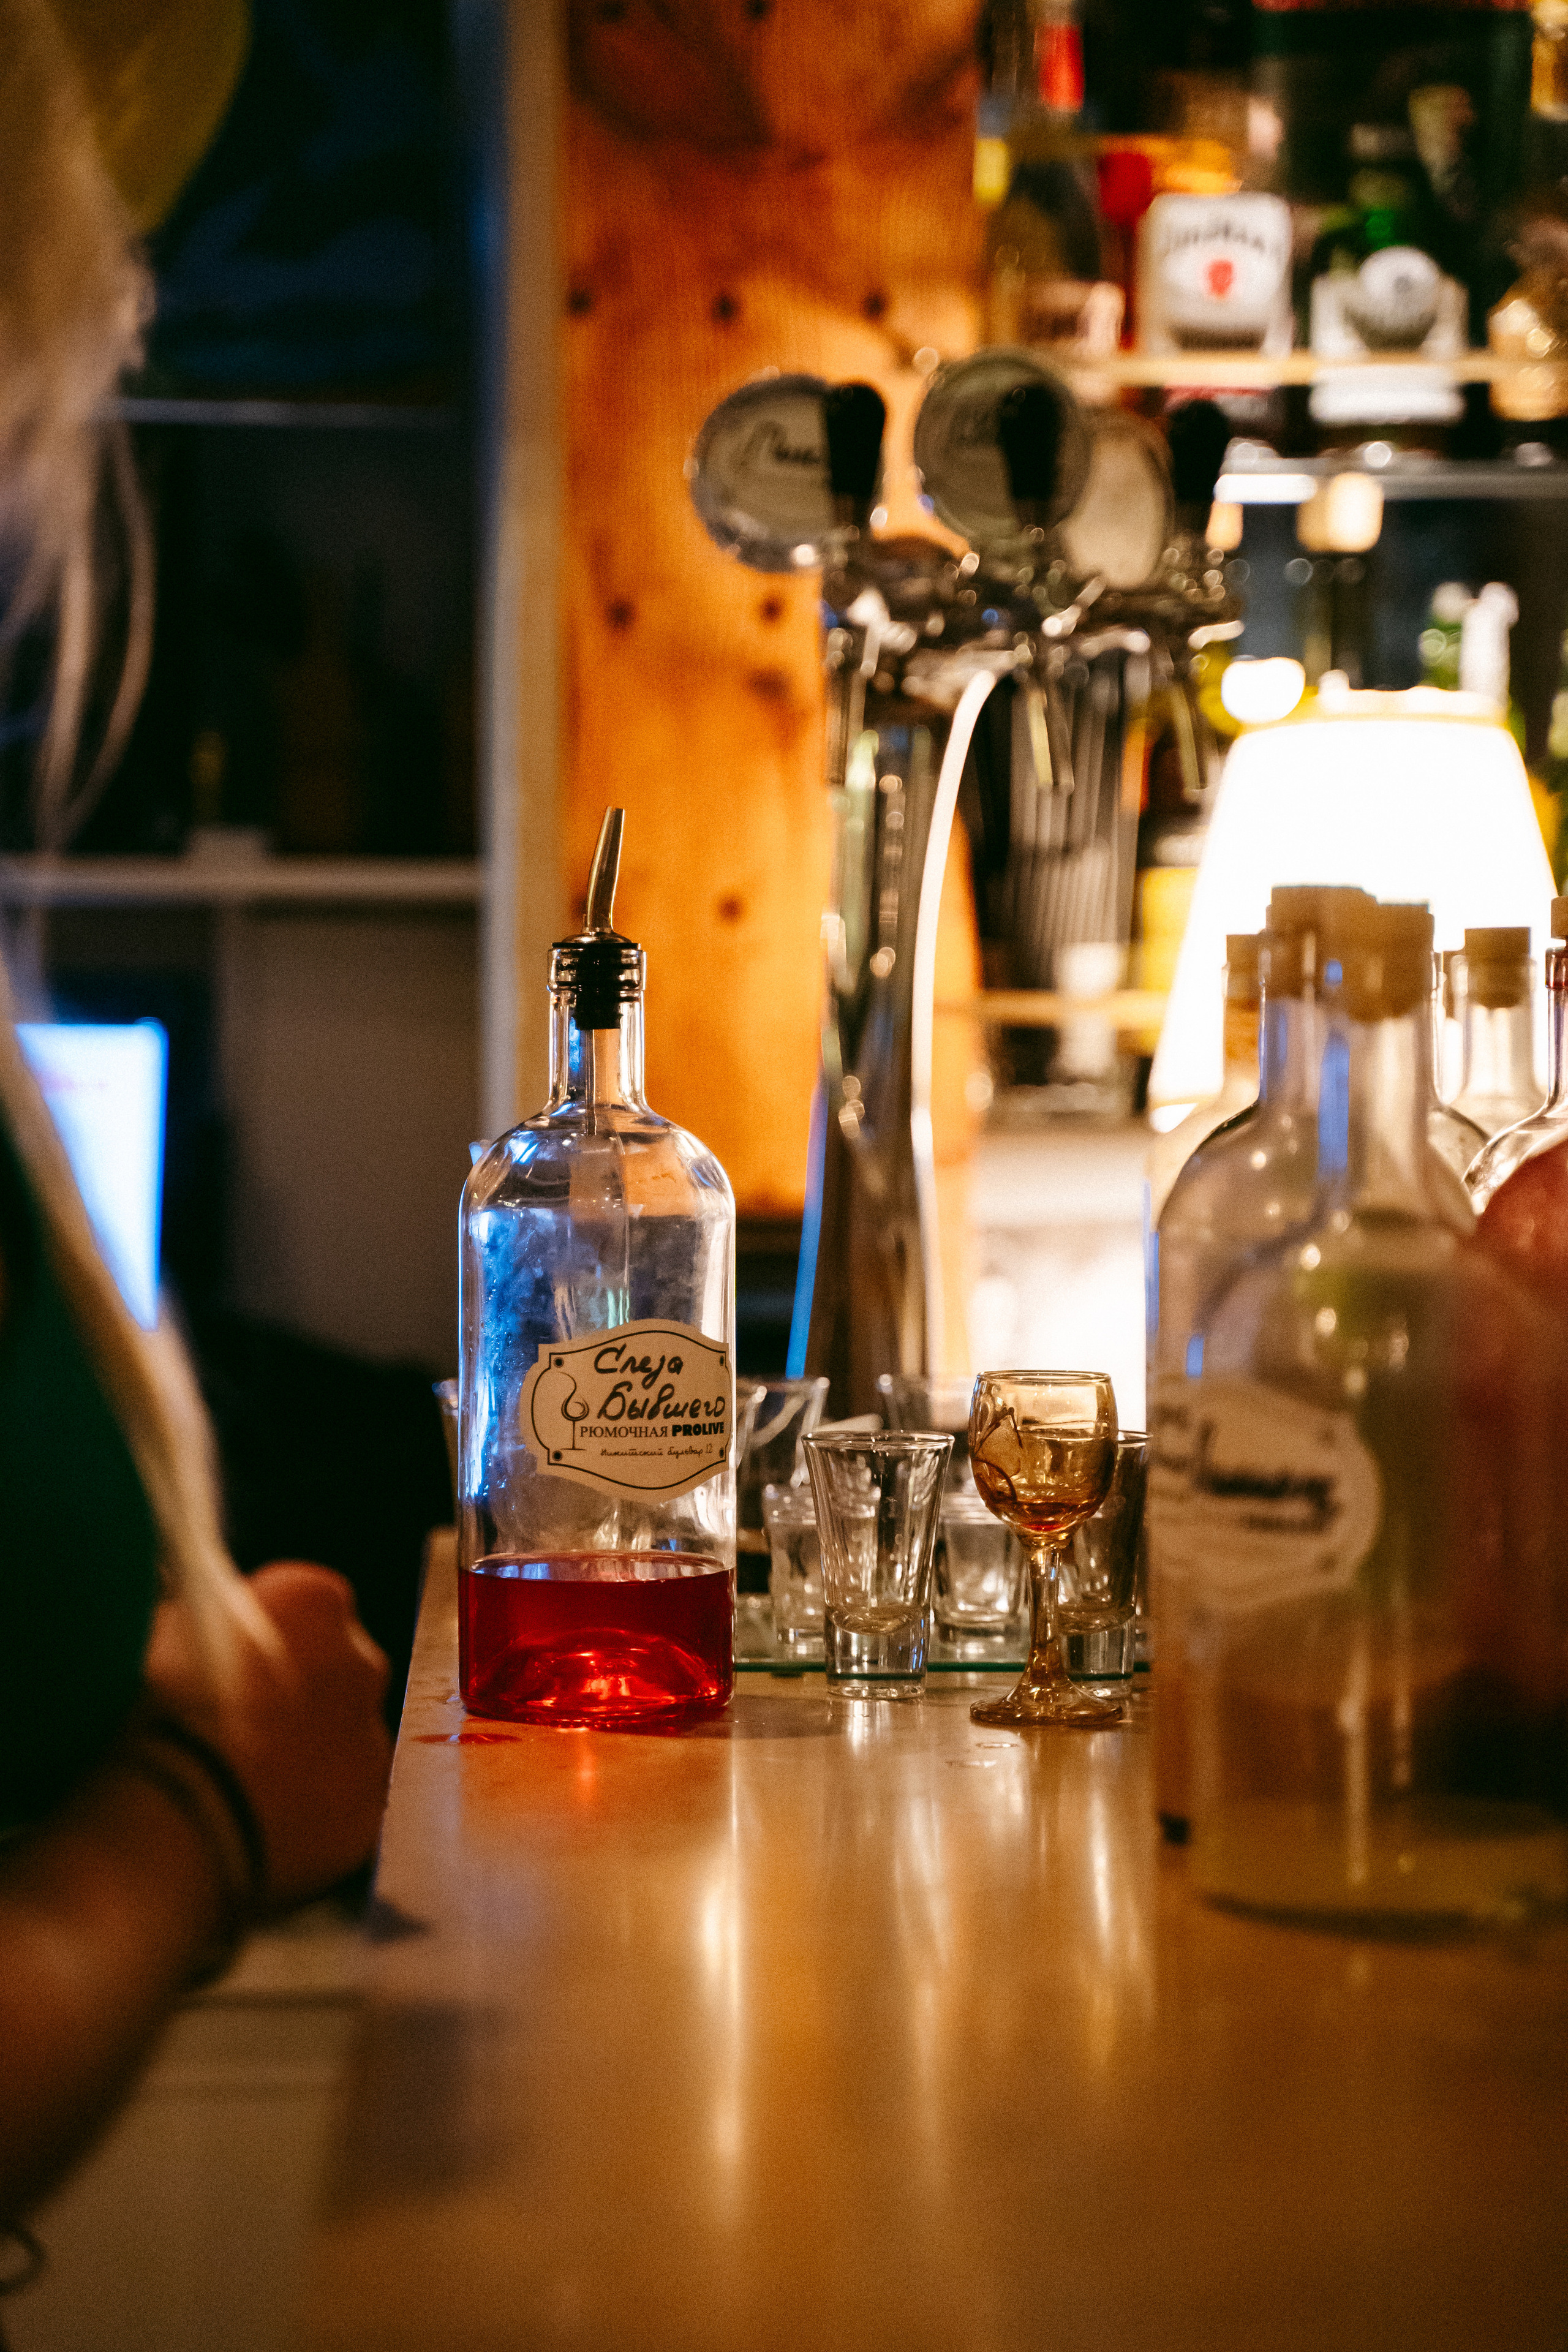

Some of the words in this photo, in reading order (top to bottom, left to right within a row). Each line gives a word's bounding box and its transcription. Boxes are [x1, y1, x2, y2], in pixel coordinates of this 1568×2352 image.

[597, 1381, 725, 1421] Бывшего
[580, 1426, 668, 1438] РЮМОЧНАЯ
[672, 1422, 724, 1436] PROLIVE
[668, 1446, 703, 1459] бульвар
